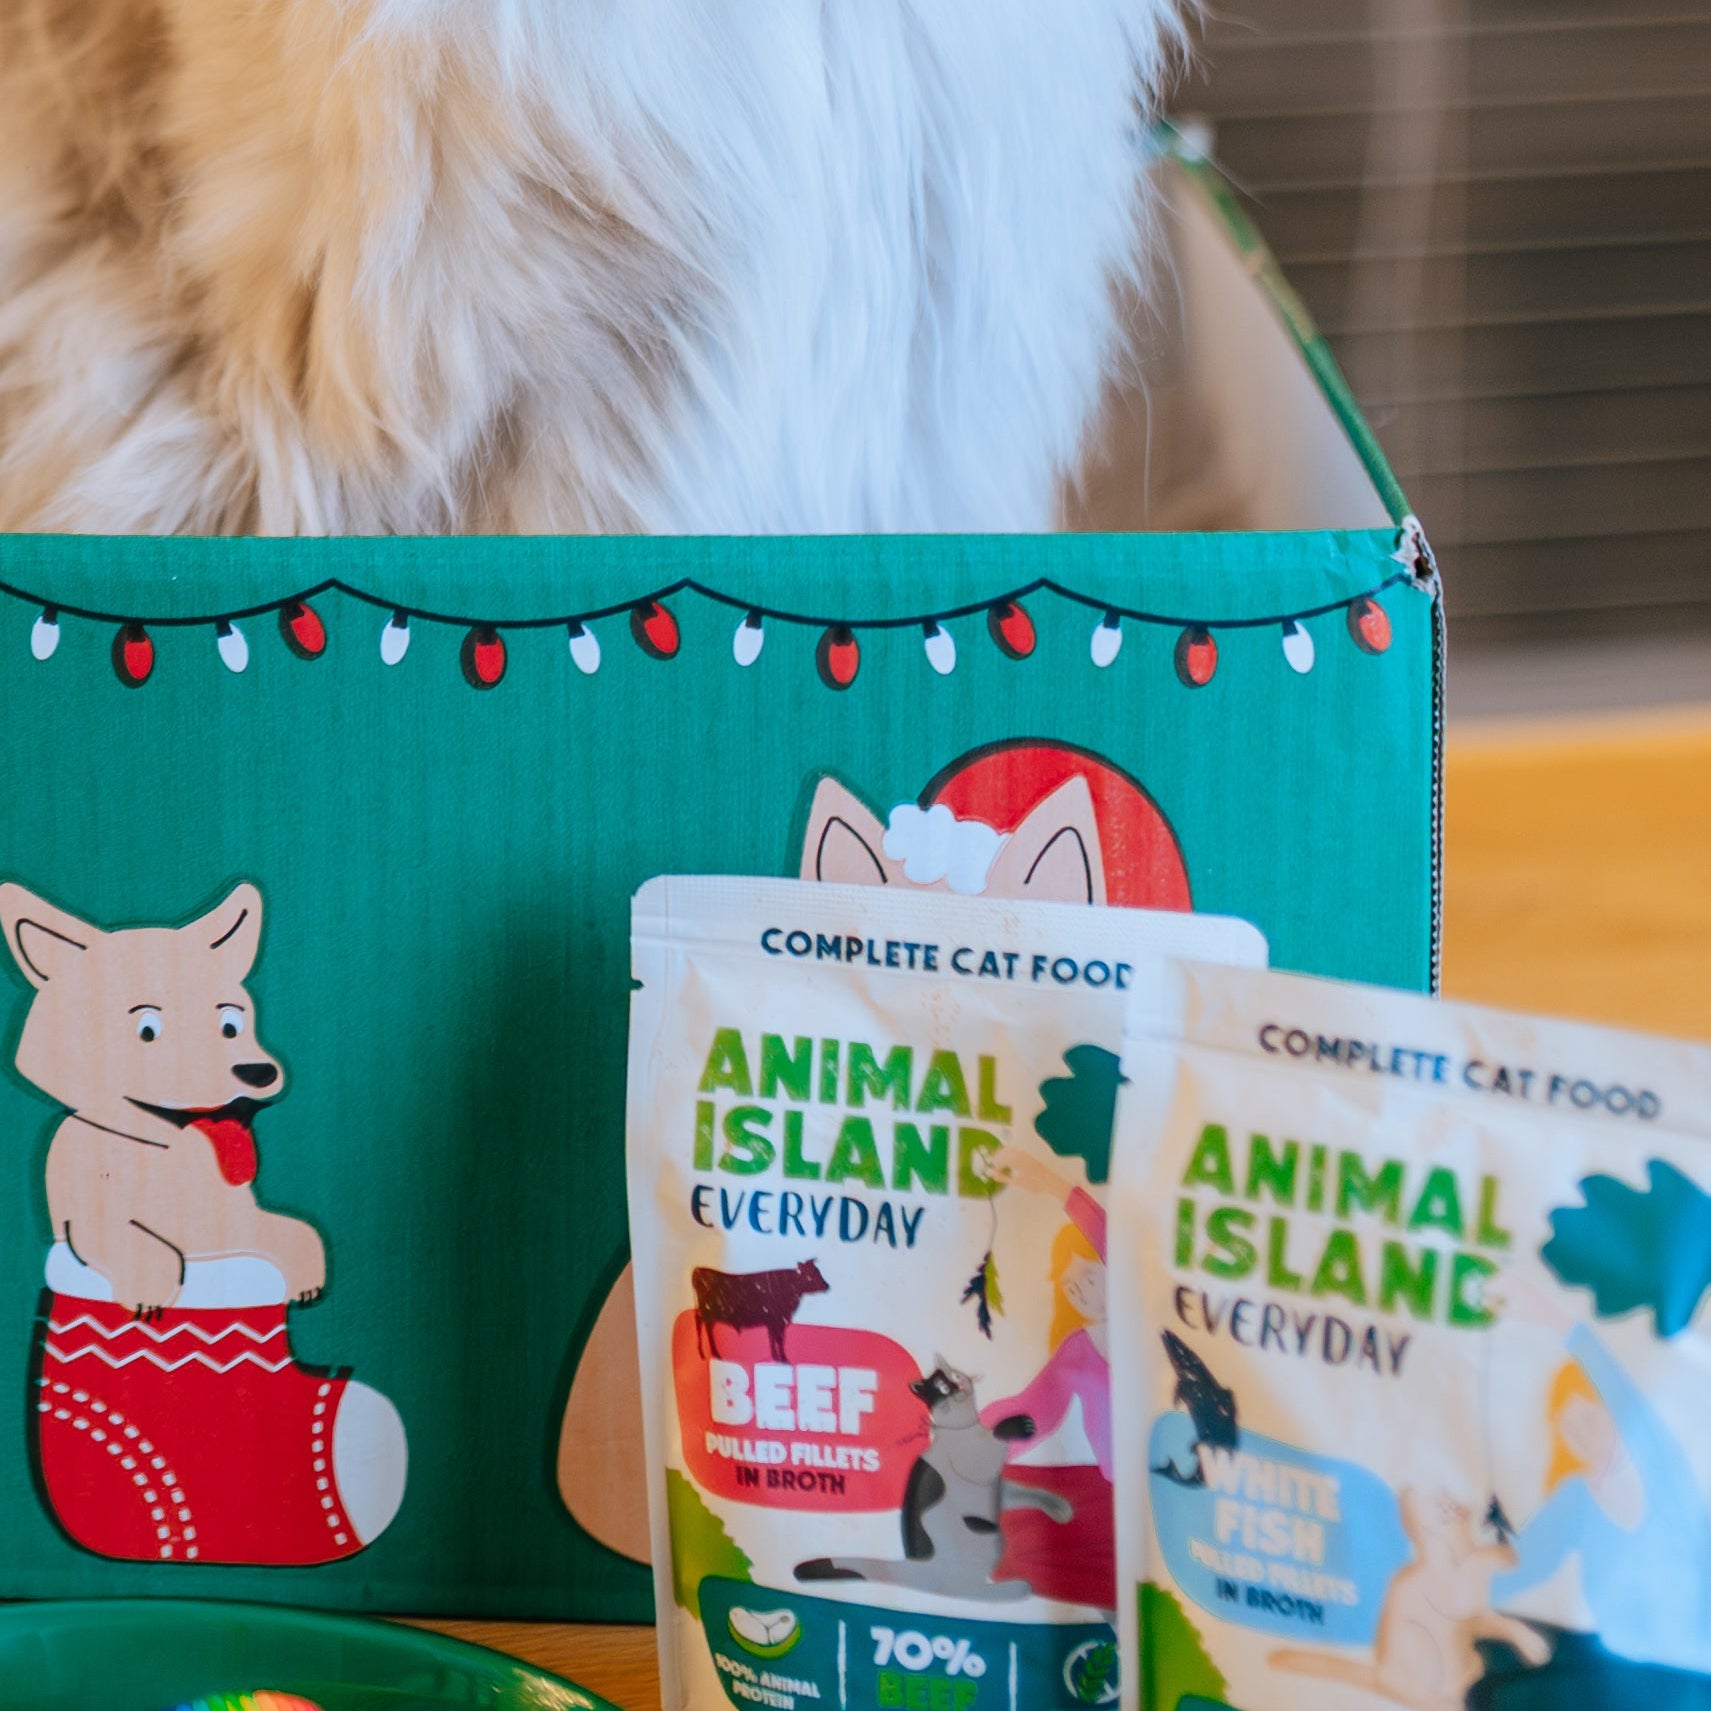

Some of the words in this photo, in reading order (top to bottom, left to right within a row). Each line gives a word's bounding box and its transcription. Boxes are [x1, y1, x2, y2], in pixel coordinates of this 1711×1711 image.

[761, 927, 938, 972] COMPLETE
[951, 947, 1019, 979] CAT
[698, 1027, 1012, 1125] ANIMAL
[1258, 1023, 1449, 1084] COMPLETE
[1462, 1058, 1534, 1099] CAT
[1548, 1073, 1662, 1120] FOOD
[691, 1100, 1014, 1199] ISLAND
[690, 1184, 925, 1250] EVERYDAY
[1182, 1122, 1511, 1249] ANIMAL
[1174, 1196, 1506, 1329] ISLAND
[1174, 1284, 1412, 1378] EVERYDAY
[709, 1358, 878, 1435] BEEF
[704, 1430, 787, 1464] PULLED
[790, 1441, 880, 1472] FILLETS
[736, 1465, 760, 1487] IN
[767, 1468, 846, 1495] BROTH
[1196, 1443, 1341, 1523] WHITE
[1215, 1497, 1324, 1566] FISH
[1216, 1576, 1239, 1604] IN
[1245, 1584, 1325, 1626] BROTH
[760, 1670, 821, 1700] ANIMAL
[870, 1625, 987, 1678] 70%
[732, 1679, 796, 1711] PROTEIN
[876, 1669, 979, 1711] BEEF
